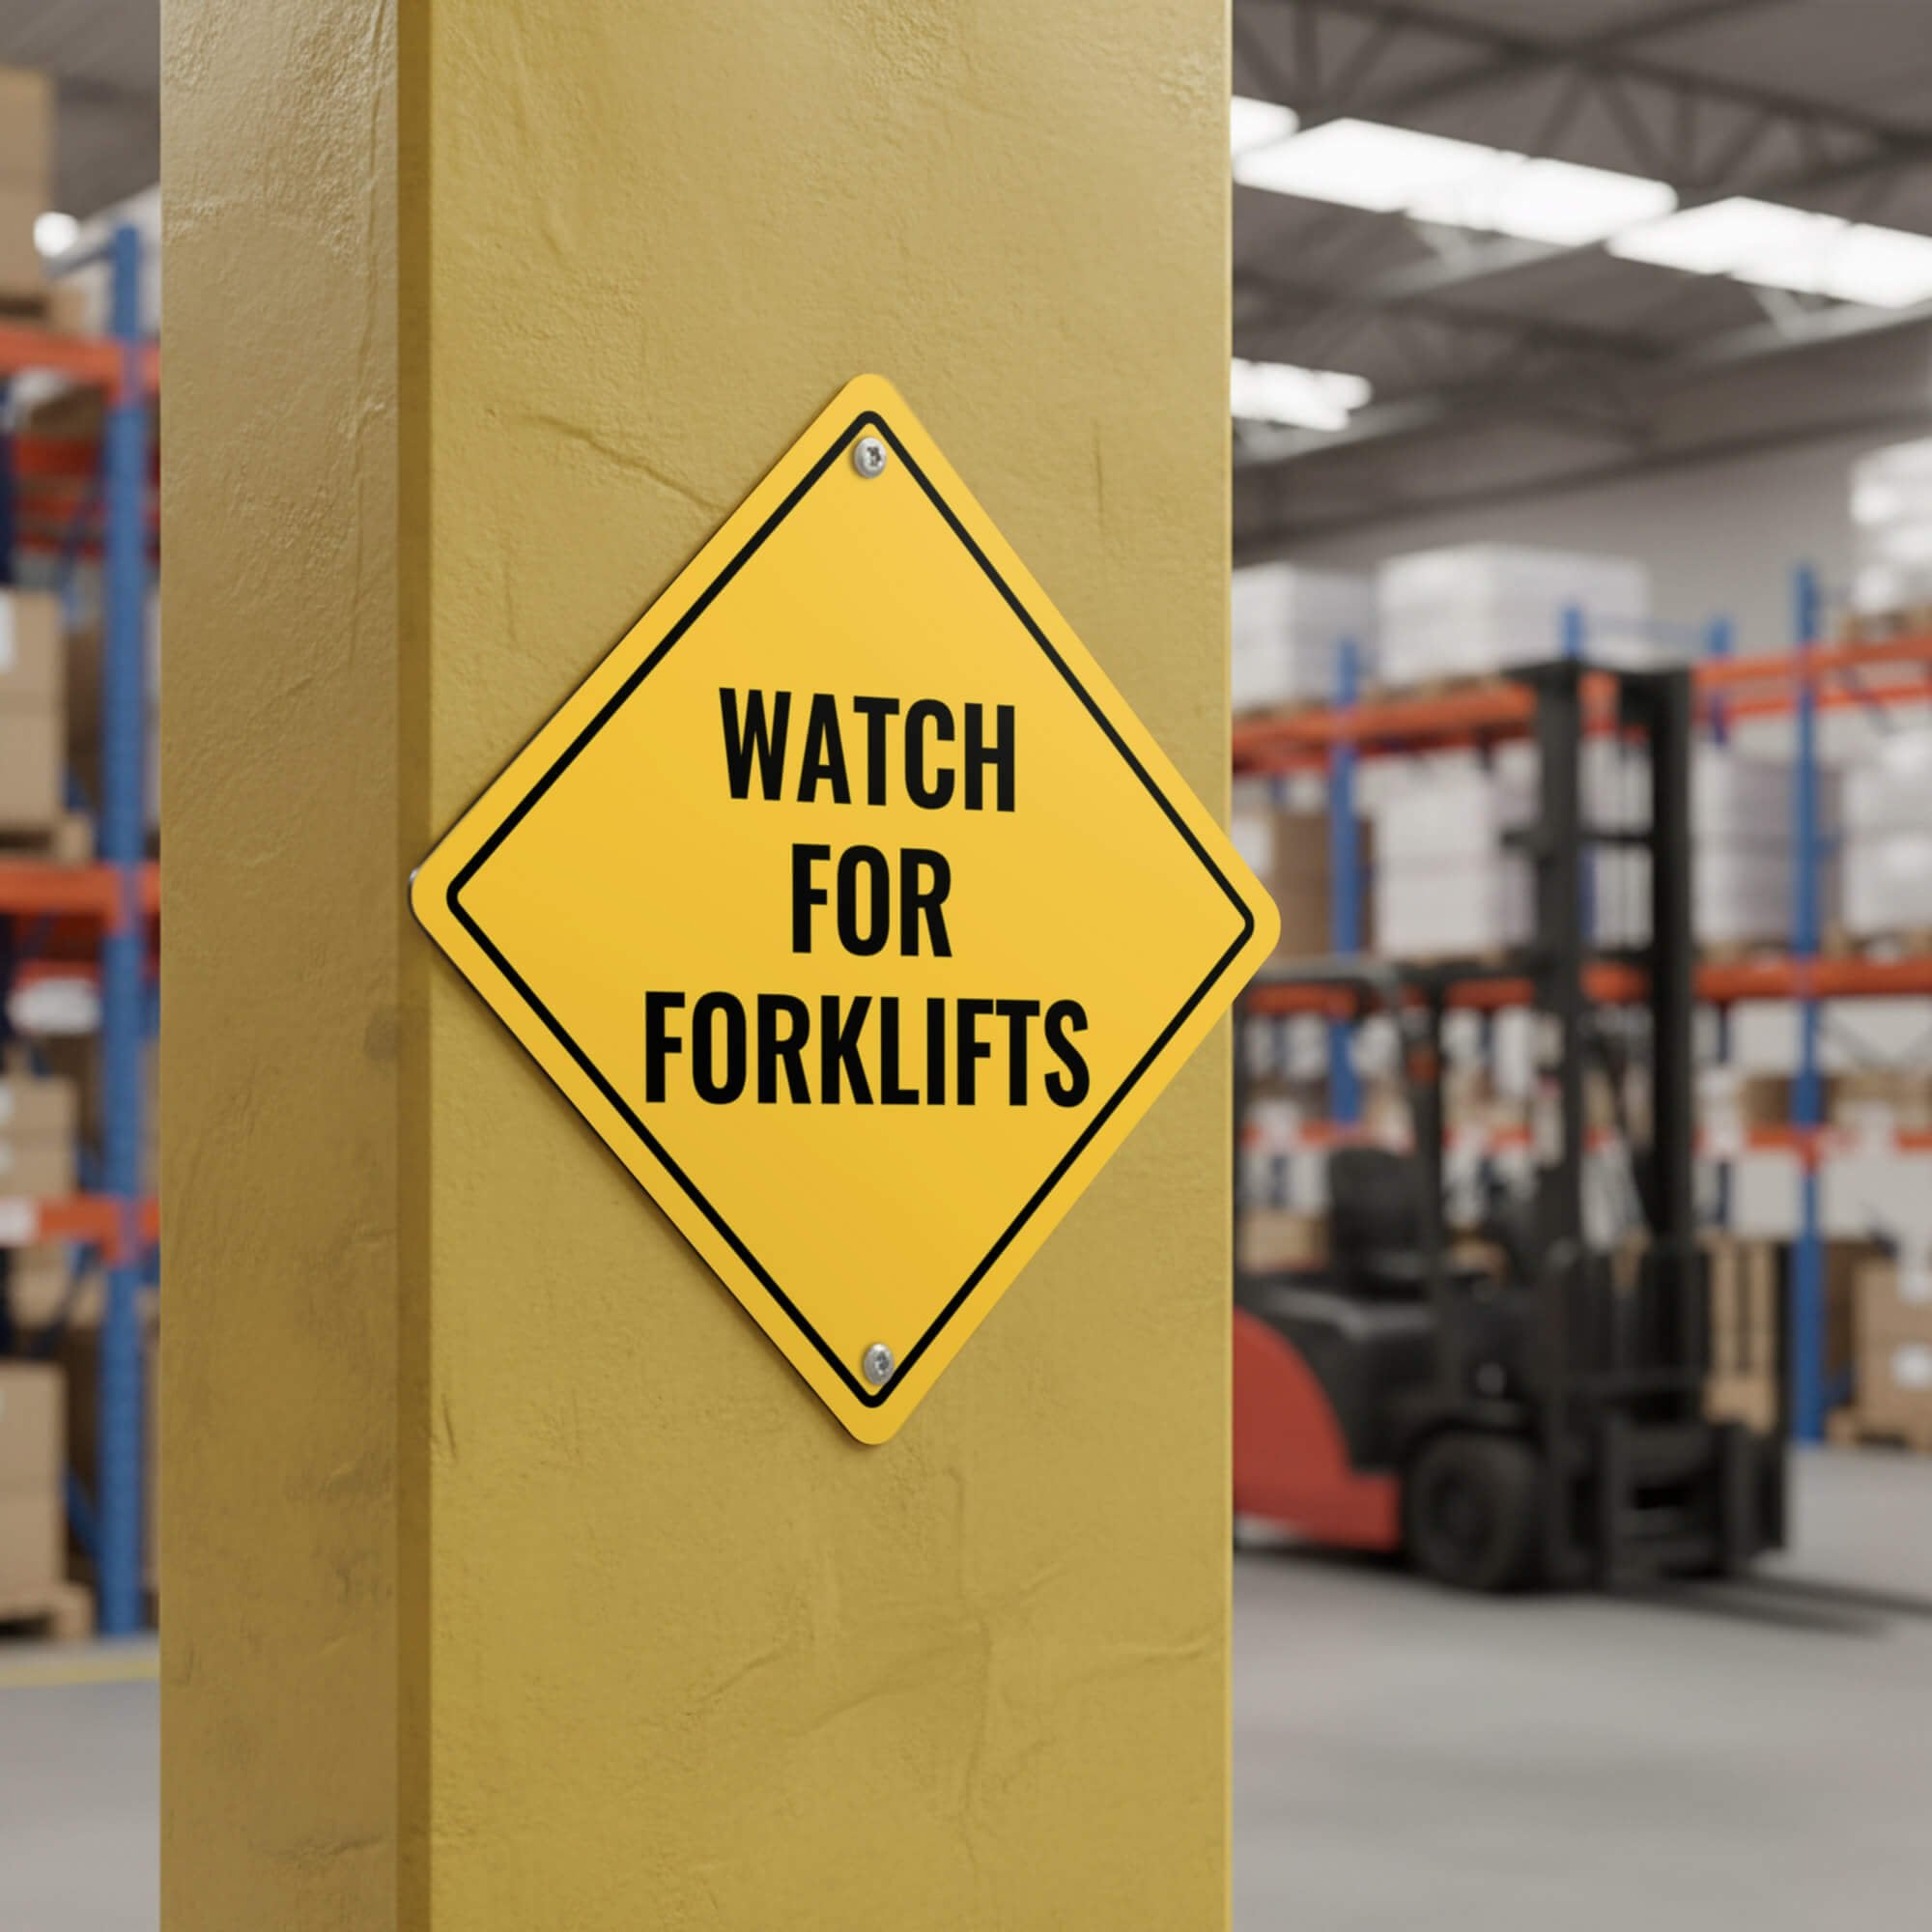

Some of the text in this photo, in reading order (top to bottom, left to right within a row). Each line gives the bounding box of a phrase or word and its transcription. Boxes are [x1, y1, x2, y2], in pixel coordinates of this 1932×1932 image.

[719, 687, 1015, 812] WATCH
[792, 843, 952, 956] FOR
[645, 990, 1091, 1108] FORKLIFTS
